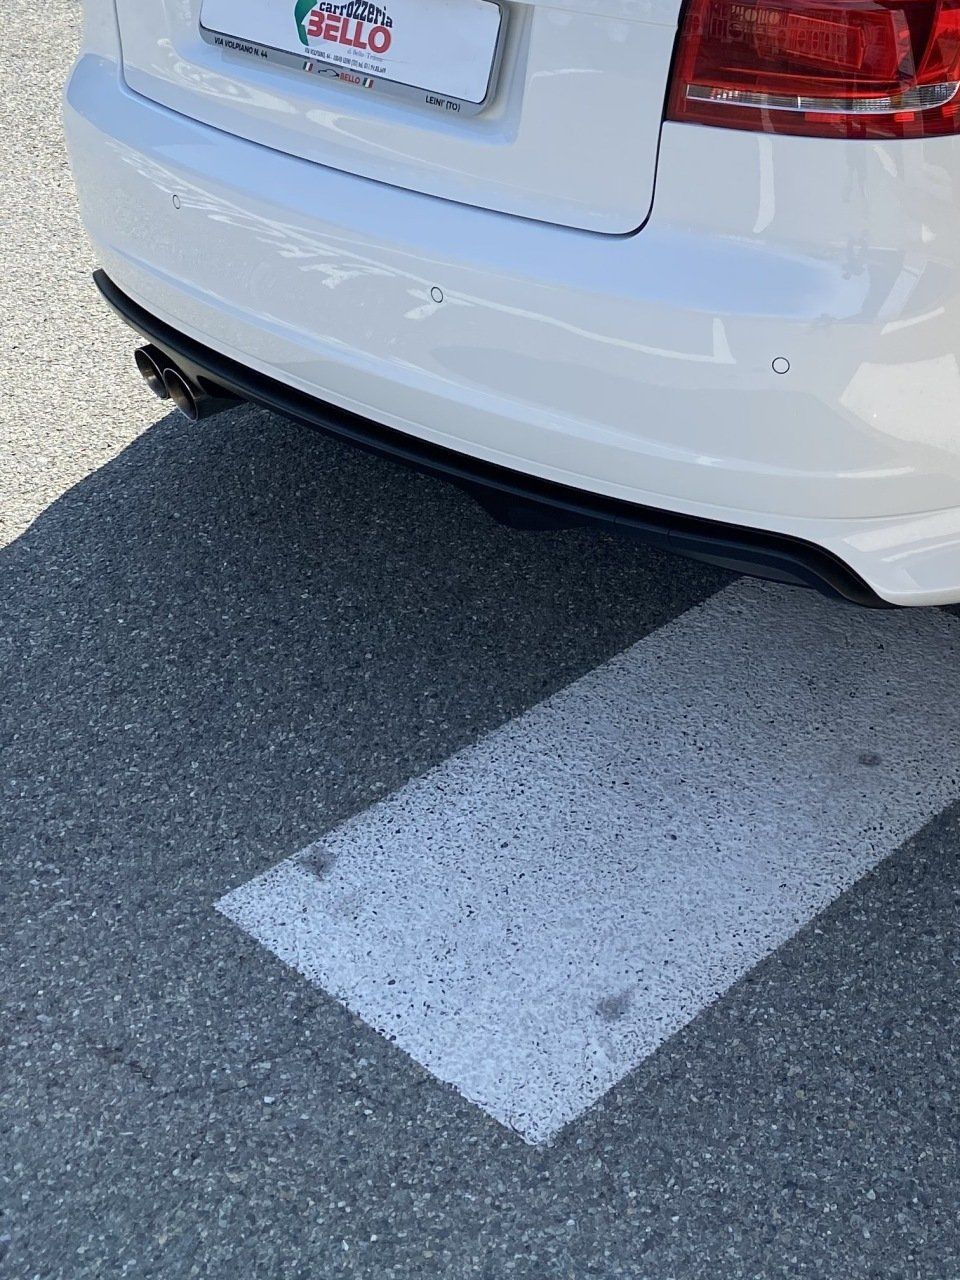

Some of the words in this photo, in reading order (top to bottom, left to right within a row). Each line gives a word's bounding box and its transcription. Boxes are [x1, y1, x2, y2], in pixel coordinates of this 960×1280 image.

[320, 0, 393, 28] carrozzeria
[307, 10, 391, 54] BELLO
[214, 37, 224, 47] VIA
[225, 40, 253, 55] VOLPIANO
[340, 73, 360, 84] BELLO
[446, 101, 461, 113] (TO)
